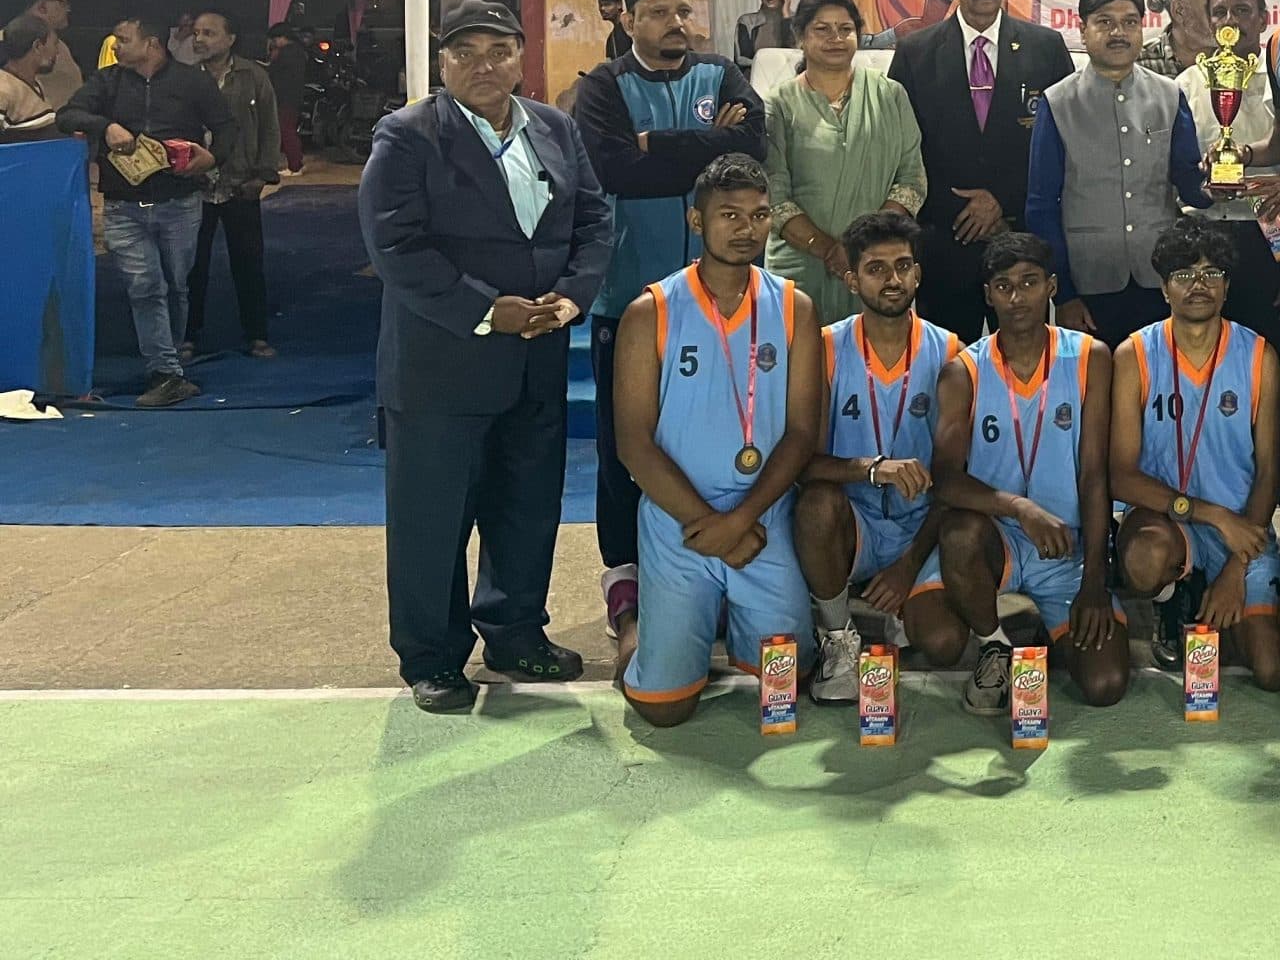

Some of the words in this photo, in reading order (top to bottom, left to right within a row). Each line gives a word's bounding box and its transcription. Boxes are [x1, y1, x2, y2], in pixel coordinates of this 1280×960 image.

[679, 345, 699, 377] 5
[841, 393, 861, 421] 4
[1152, 393, 1184, 422] 10
[981, 414, 1000, 444] 6
